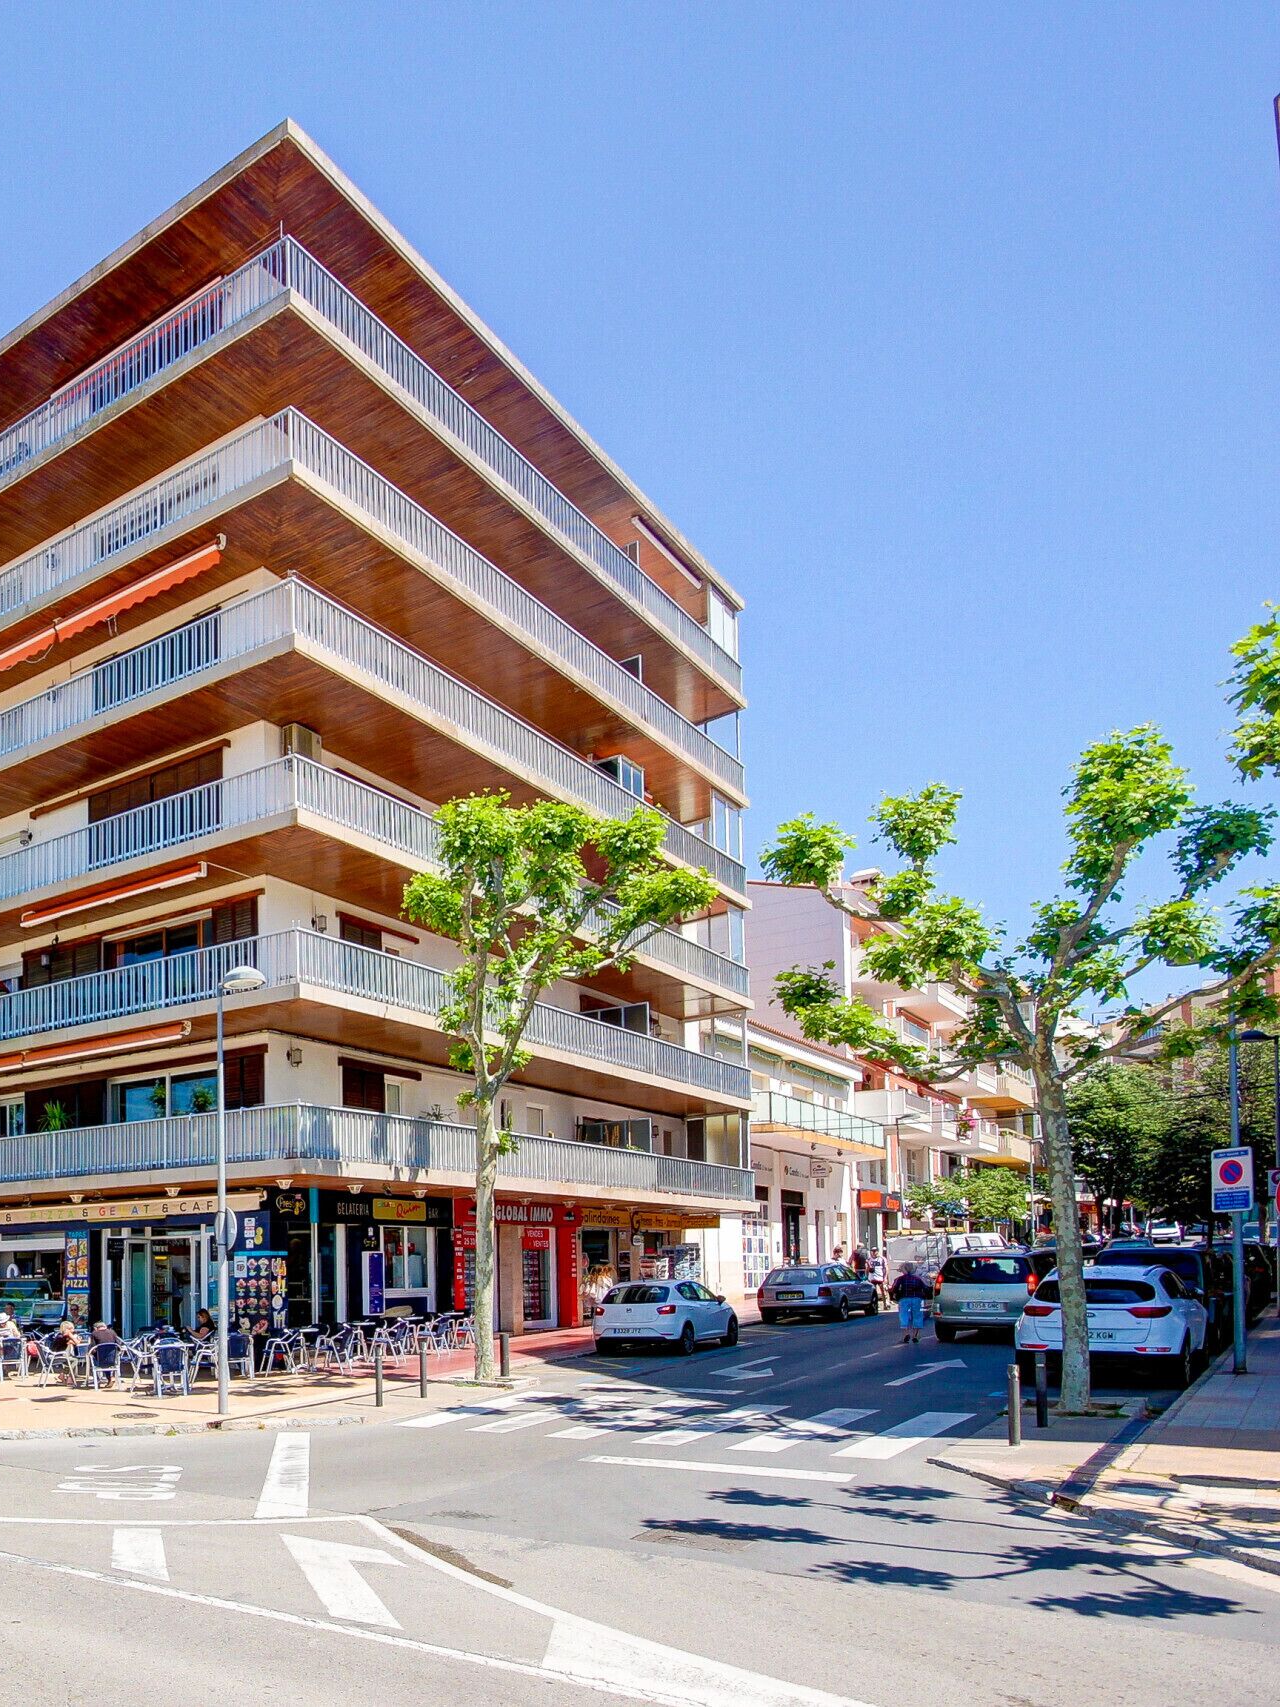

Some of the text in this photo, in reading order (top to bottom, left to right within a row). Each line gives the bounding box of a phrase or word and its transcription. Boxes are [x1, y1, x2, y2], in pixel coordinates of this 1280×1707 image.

[179, 1200, 214, 1213] CAF
[337, 1202, 370, 1216] GELATERIA
[495, 1204, 554, 1222] GLOBAL IMMO
[527, 1230, 544, 1238] VENDES
[533, 1240, 549, 1248] VENTES
[65, 1279, 89, 1288] PIZZA
